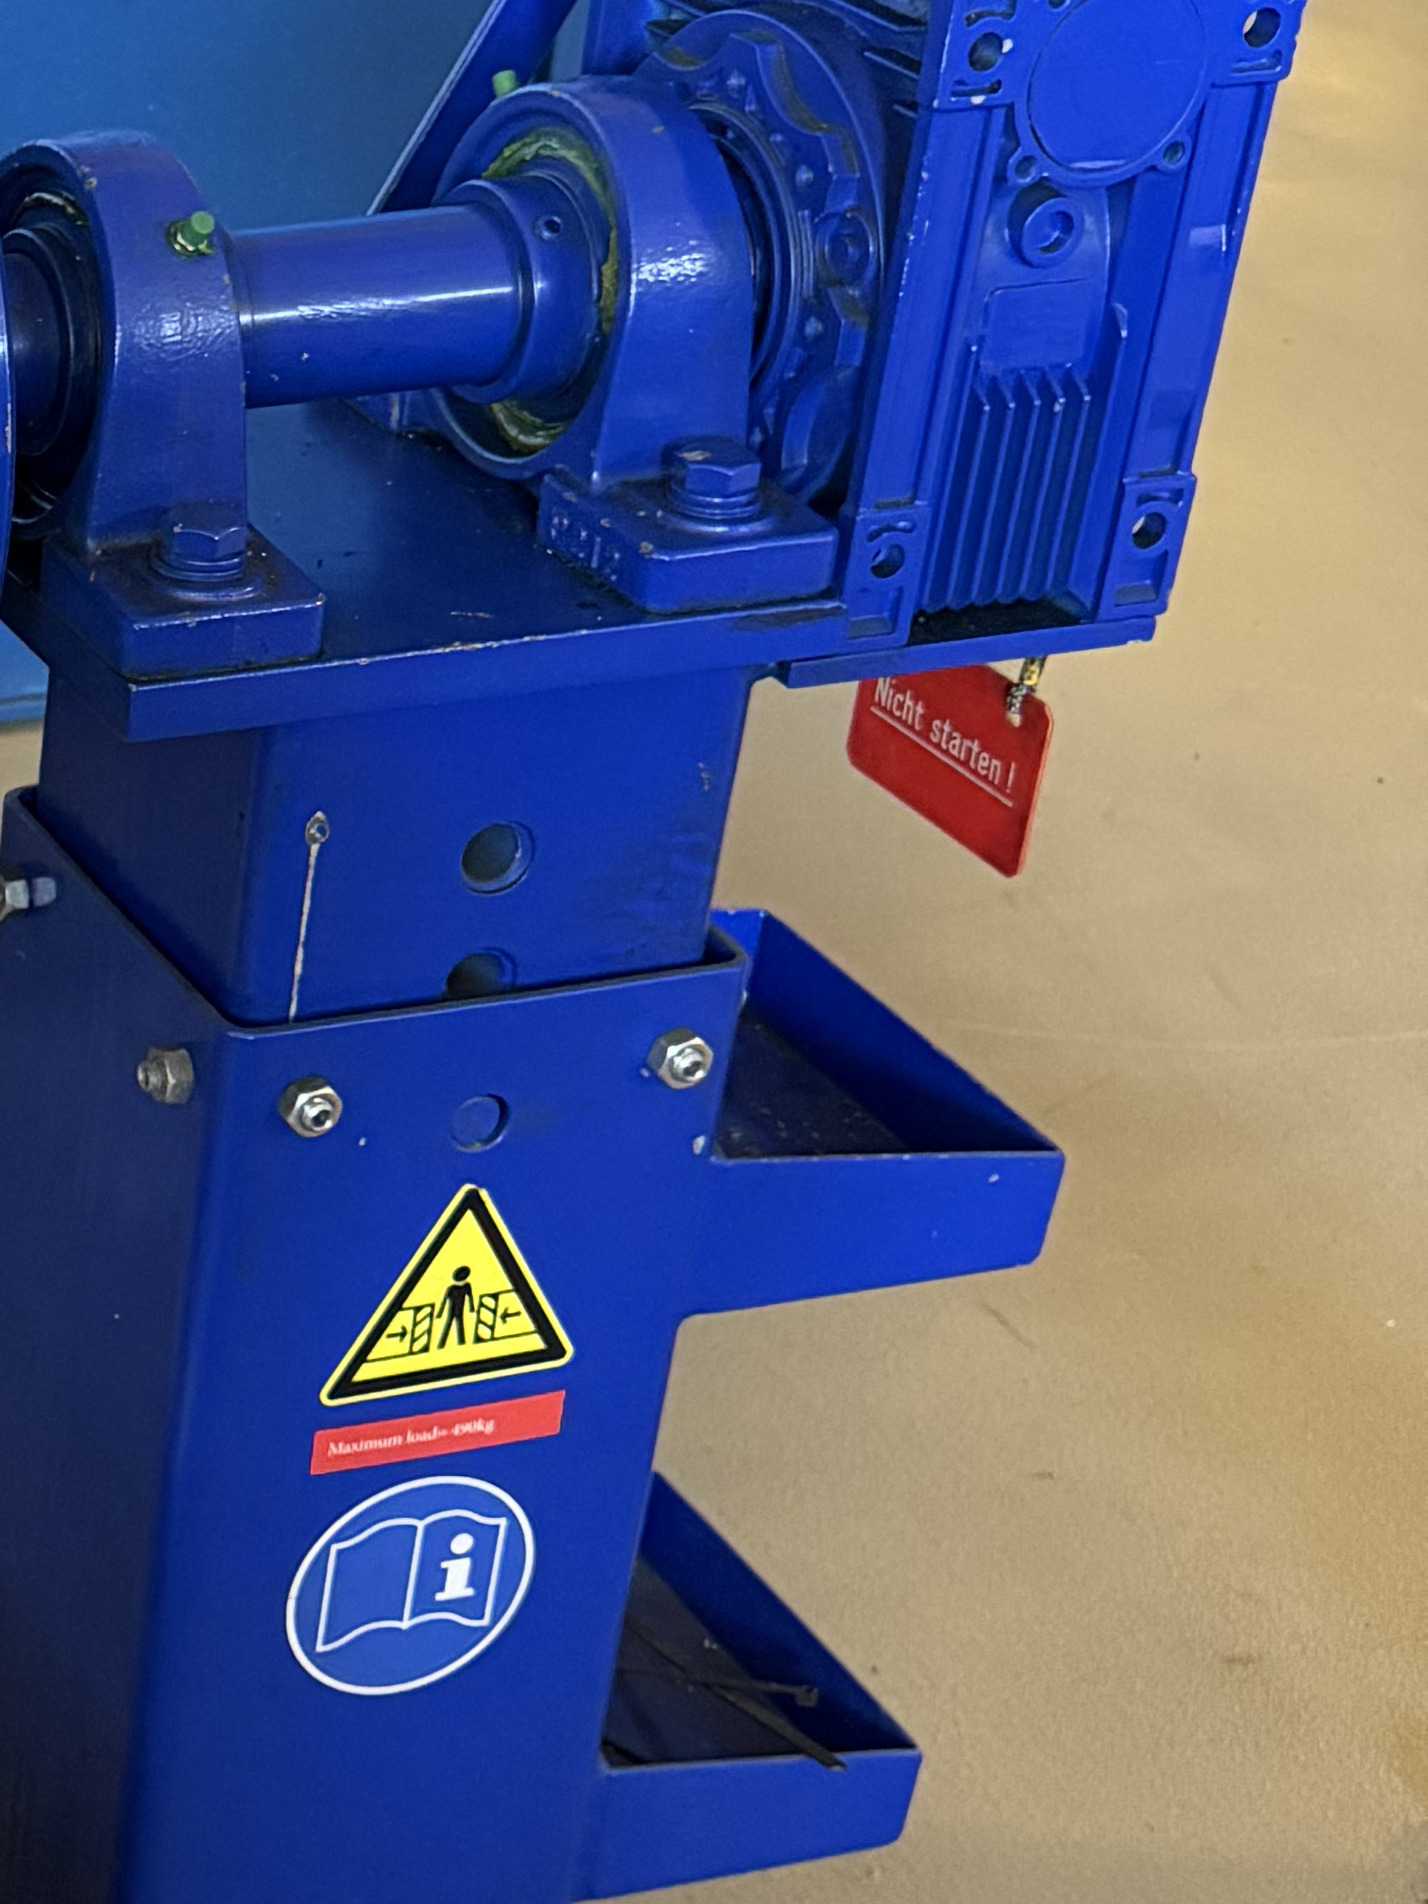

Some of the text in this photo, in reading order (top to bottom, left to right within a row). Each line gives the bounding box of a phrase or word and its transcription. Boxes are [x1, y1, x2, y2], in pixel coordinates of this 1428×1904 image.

[874, 676, 1016, 794] Nicht starten !
[327, 1434, 403, 1457] Maximum
